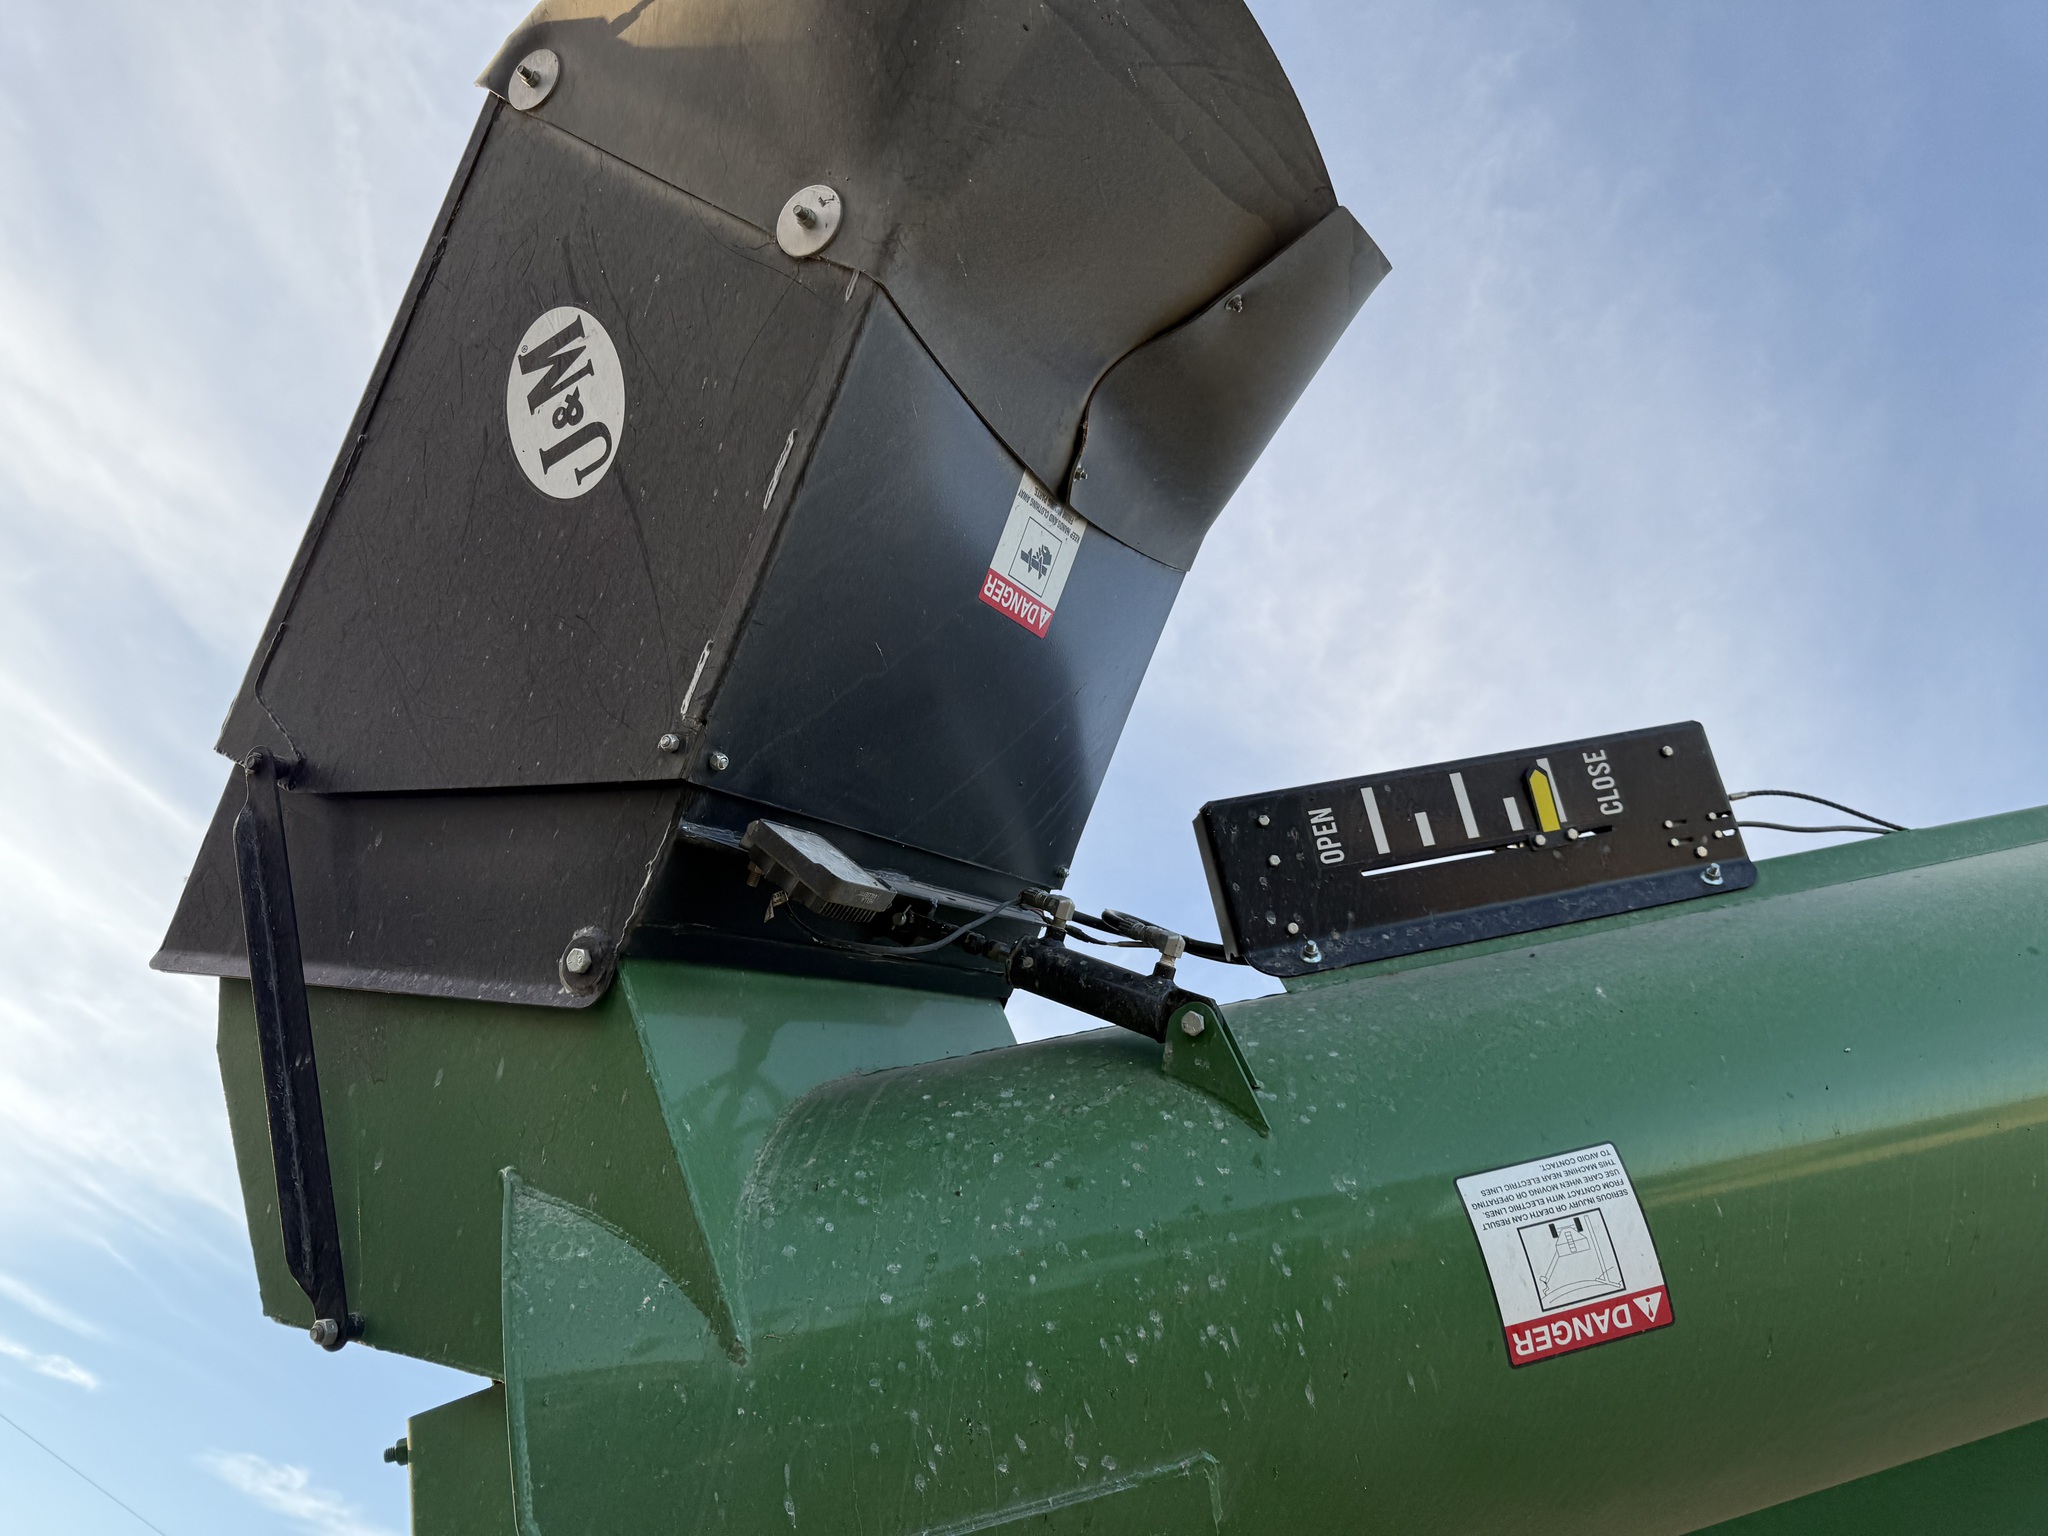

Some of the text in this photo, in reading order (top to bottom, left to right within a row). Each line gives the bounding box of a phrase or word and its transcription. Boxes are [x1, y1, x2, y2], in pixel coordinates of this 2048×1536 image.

[1018, 489, 1080, 543] KEEP HANDS AND CLOTHING AWAY
[983, 574, 1040, 625] DANGER
[1582, 749, 1624, 815] CLOSE
[1307, 807, 1345, 865] OPEN
[1481, 1159, 1615, 1196] THIS MACHINE NEAR ELECTRIC LINES
[1539, 1157, 1575, 1171] CONTACT.
[1577, 1151, 1599, 1163] AVOID
[1472, 1169, 1619, 1210] USE CARE WHEN MOVING OR OPERATING
[1482, 1189, 1628, 1230] SERIOUS INJURY OR DEATH CAN RESULT
[1483, 1178, 1624, 1218] FROM CONTACT WITH ELECTRIC LINES.
[1512, 1303, 1633, 1356] DANGER
